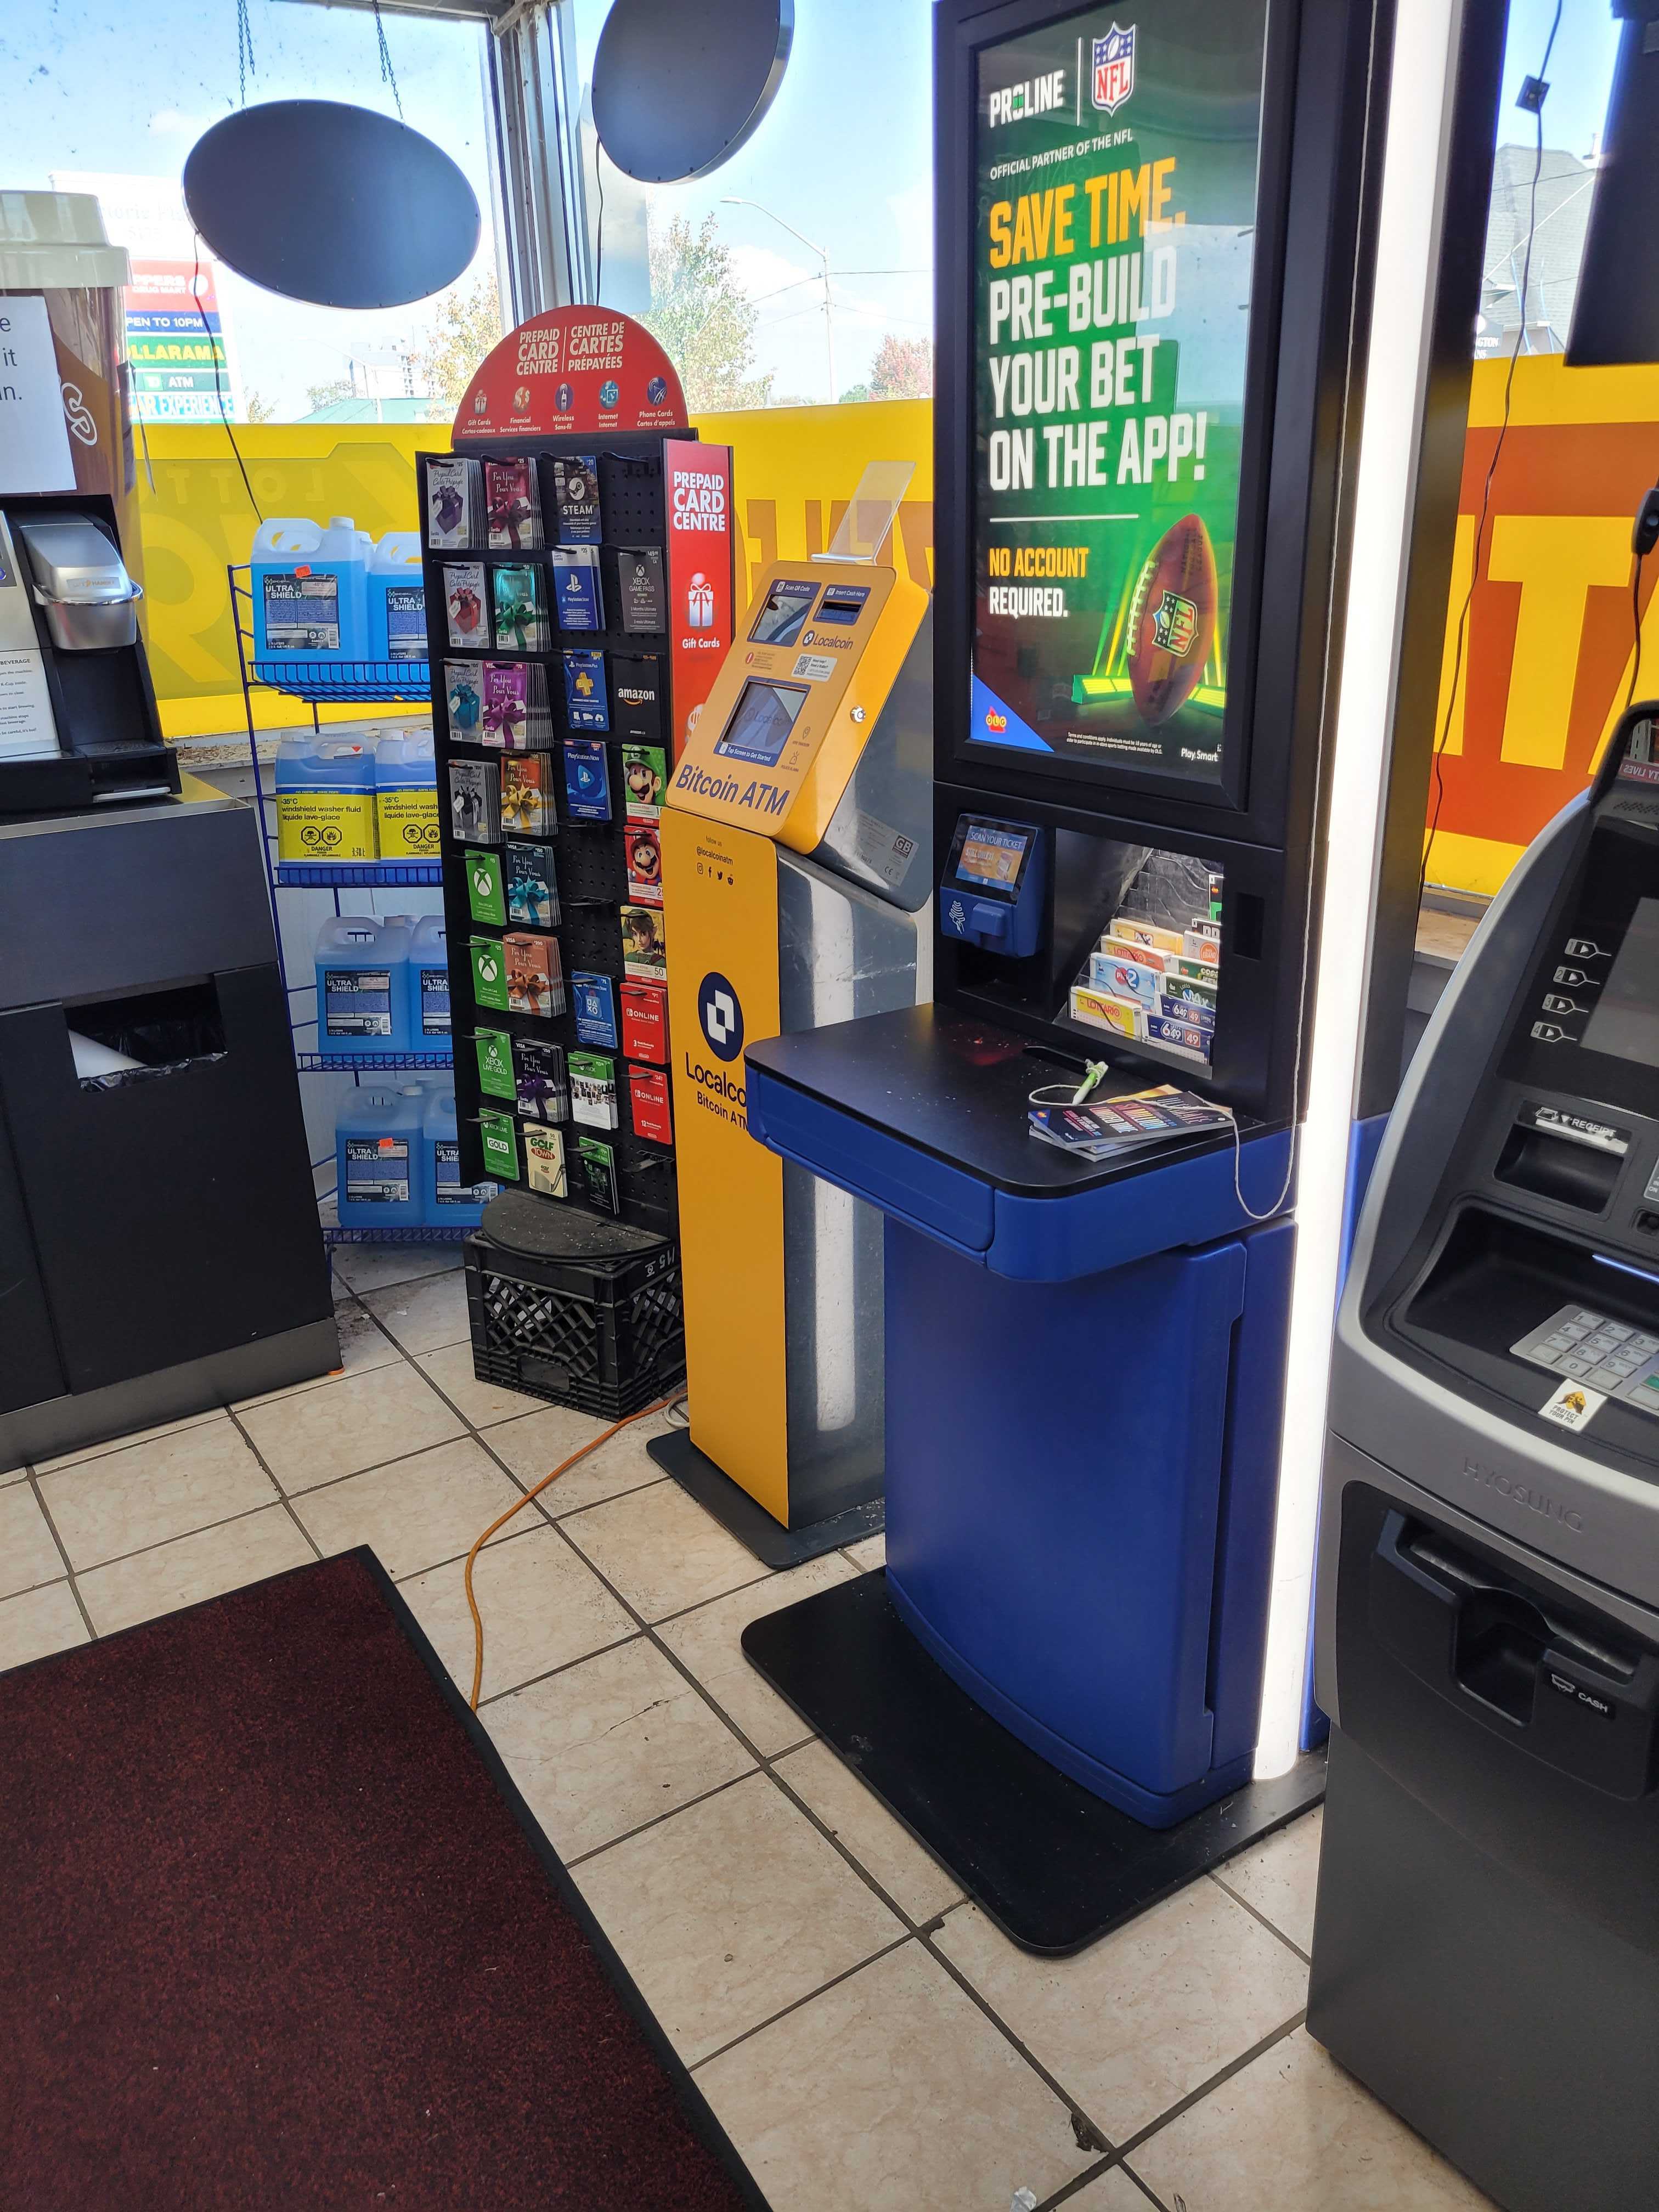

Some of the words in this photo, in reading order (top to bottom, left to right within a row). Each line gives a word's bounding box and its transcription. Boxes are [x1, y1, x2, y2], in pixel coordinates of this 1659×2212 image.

[1096, 61, 1128, 103] NFL
[990, 70, 1065, 128] PROLINE
[990, 160, 1031, 180] OFFICIAL
[1032, 144, 1074, 168] PARTNER
[1076, 141, 1090, 156] OF
[1092, 135, 1111, 151] THE
[1114, 128, 1133, 145] NFL
[990, 184, 1075, 269] SAVE
[1085, 157, 1186, 248] TIME.
[990, 245, 1176, 345] PRE-BUILD
[153, 318, 171, 327] TO
[174, 318, 202, 327] 10PM
[571, 324, 608, 338] CENTRE
[612, 321, 625, 334] DE
[520, 329, 560, 343] PREPAID
[518, 341, 559, 362] CARD
[569, 335, 623, 356] CARTES
[3, 348, 18, 366] it
[568, 353, 623, 372] PRÉPAYÉES
[516, 359, 557, 375] CENTRE
[168, 376, 194, 388] ATM
[990, 345, 1079, 418] YOUR
[1091, 334, 1159, 409] BET
[990, 428, 1032, 491] ON
[1042, 421, 1107, 488] THE
[1116, 412, 1206, 484] APP!
[674, 471, 724, 490] PREPAID
[673, 488, 725, 514] CARD
[563, 505, 593, 515] STEAM
[673, 512, 725, 532] CENTRE
[990, 548, 1011, 577] NO
[1014, 548, 1088, 577] ACCOUNT
[990, 586, 1068, 619] REQUIRED.
[1170, 606, 1193, 651] NFL
[682, 637, 696, 648] Gift
[697, 638, 720, 648] Cards
[813, 634, 853, 650] Localcoin
[490, 674, 499, 682] For
[493, 686, 505, 694] Pour
[618, 687, 655, 701] amazon
[986, 714, 1006, 727] OLG
[568, 752, 590, 761] PlayStation
[734, 748, 746, 757] Screen
[757, 753, 771, 761] Started
[676, 764, 739, 803] Bitcoin
[738, 780, 790, 816] ATM
[896, 837, 912, 853] GB
[970, 832, 986, 842] SCAN
[986, 835, 1003, 845] YOUR
[1003, 839, 1022, 850] TICKET
[513, 855, 521, 864] For
[522, 856, 533, 870] You
[696, 846, 733, 865] @localcoinatm
[528, 867, 541, 877] Vous
[884, 866, 893, 876] CE
[511, 948, 520, 957] For
[1569, 941, 1576, 954] 1
[515, 958, 527, 967] Pour
[654, 967, 663, 977] 50
[1128, 970, 1137, 988] 2
[1556, 969, 1564, 980] 2
[1087, 998, 1121, 1019] LOTTARIO
[1544, 996, 1553, 1008] 3
[634, 1011, 659, 1022] ONLINE
[1173, 1003, 1188, 1019] 649
[1189, 1012, 1199, 1022] 49
[1162, 1022, 1182, 1040] 649
[1186, 1034, 1199, 1045] 49
[1533, 1024, 1540, 1035] 4
[485, 1056, 503, 1068] XBOX
[521, 1053, 529, 1062] For
[530, 1054, 540, 1068] You
[493, 1066, 507, 1075] GOLD
[524, 1064, 535, 1073] Pour
[536, 1066, 549, 1075] Vous
[641, 1092, 664, 1103] ONLINE
[697, 1091, 728, 1121] Bitcoin
[1571, 1118, 1617, 1136] RECEIPT
[489, 1139, 507, 1151] GOLD
[531, 1138, 554, 1151] GOLF
[533, 1147, 552, 1159] TOWN
[1549, 1409, 1565, 1421] YOUR
[1564, 1416, 1575, 1425] PIN
[1552, 1405, 1579, 1420] PROTECT
[1462, 1457, 1582, 1534] HYOSUNG
[1578, 1691, 1609, 1714] CASH
